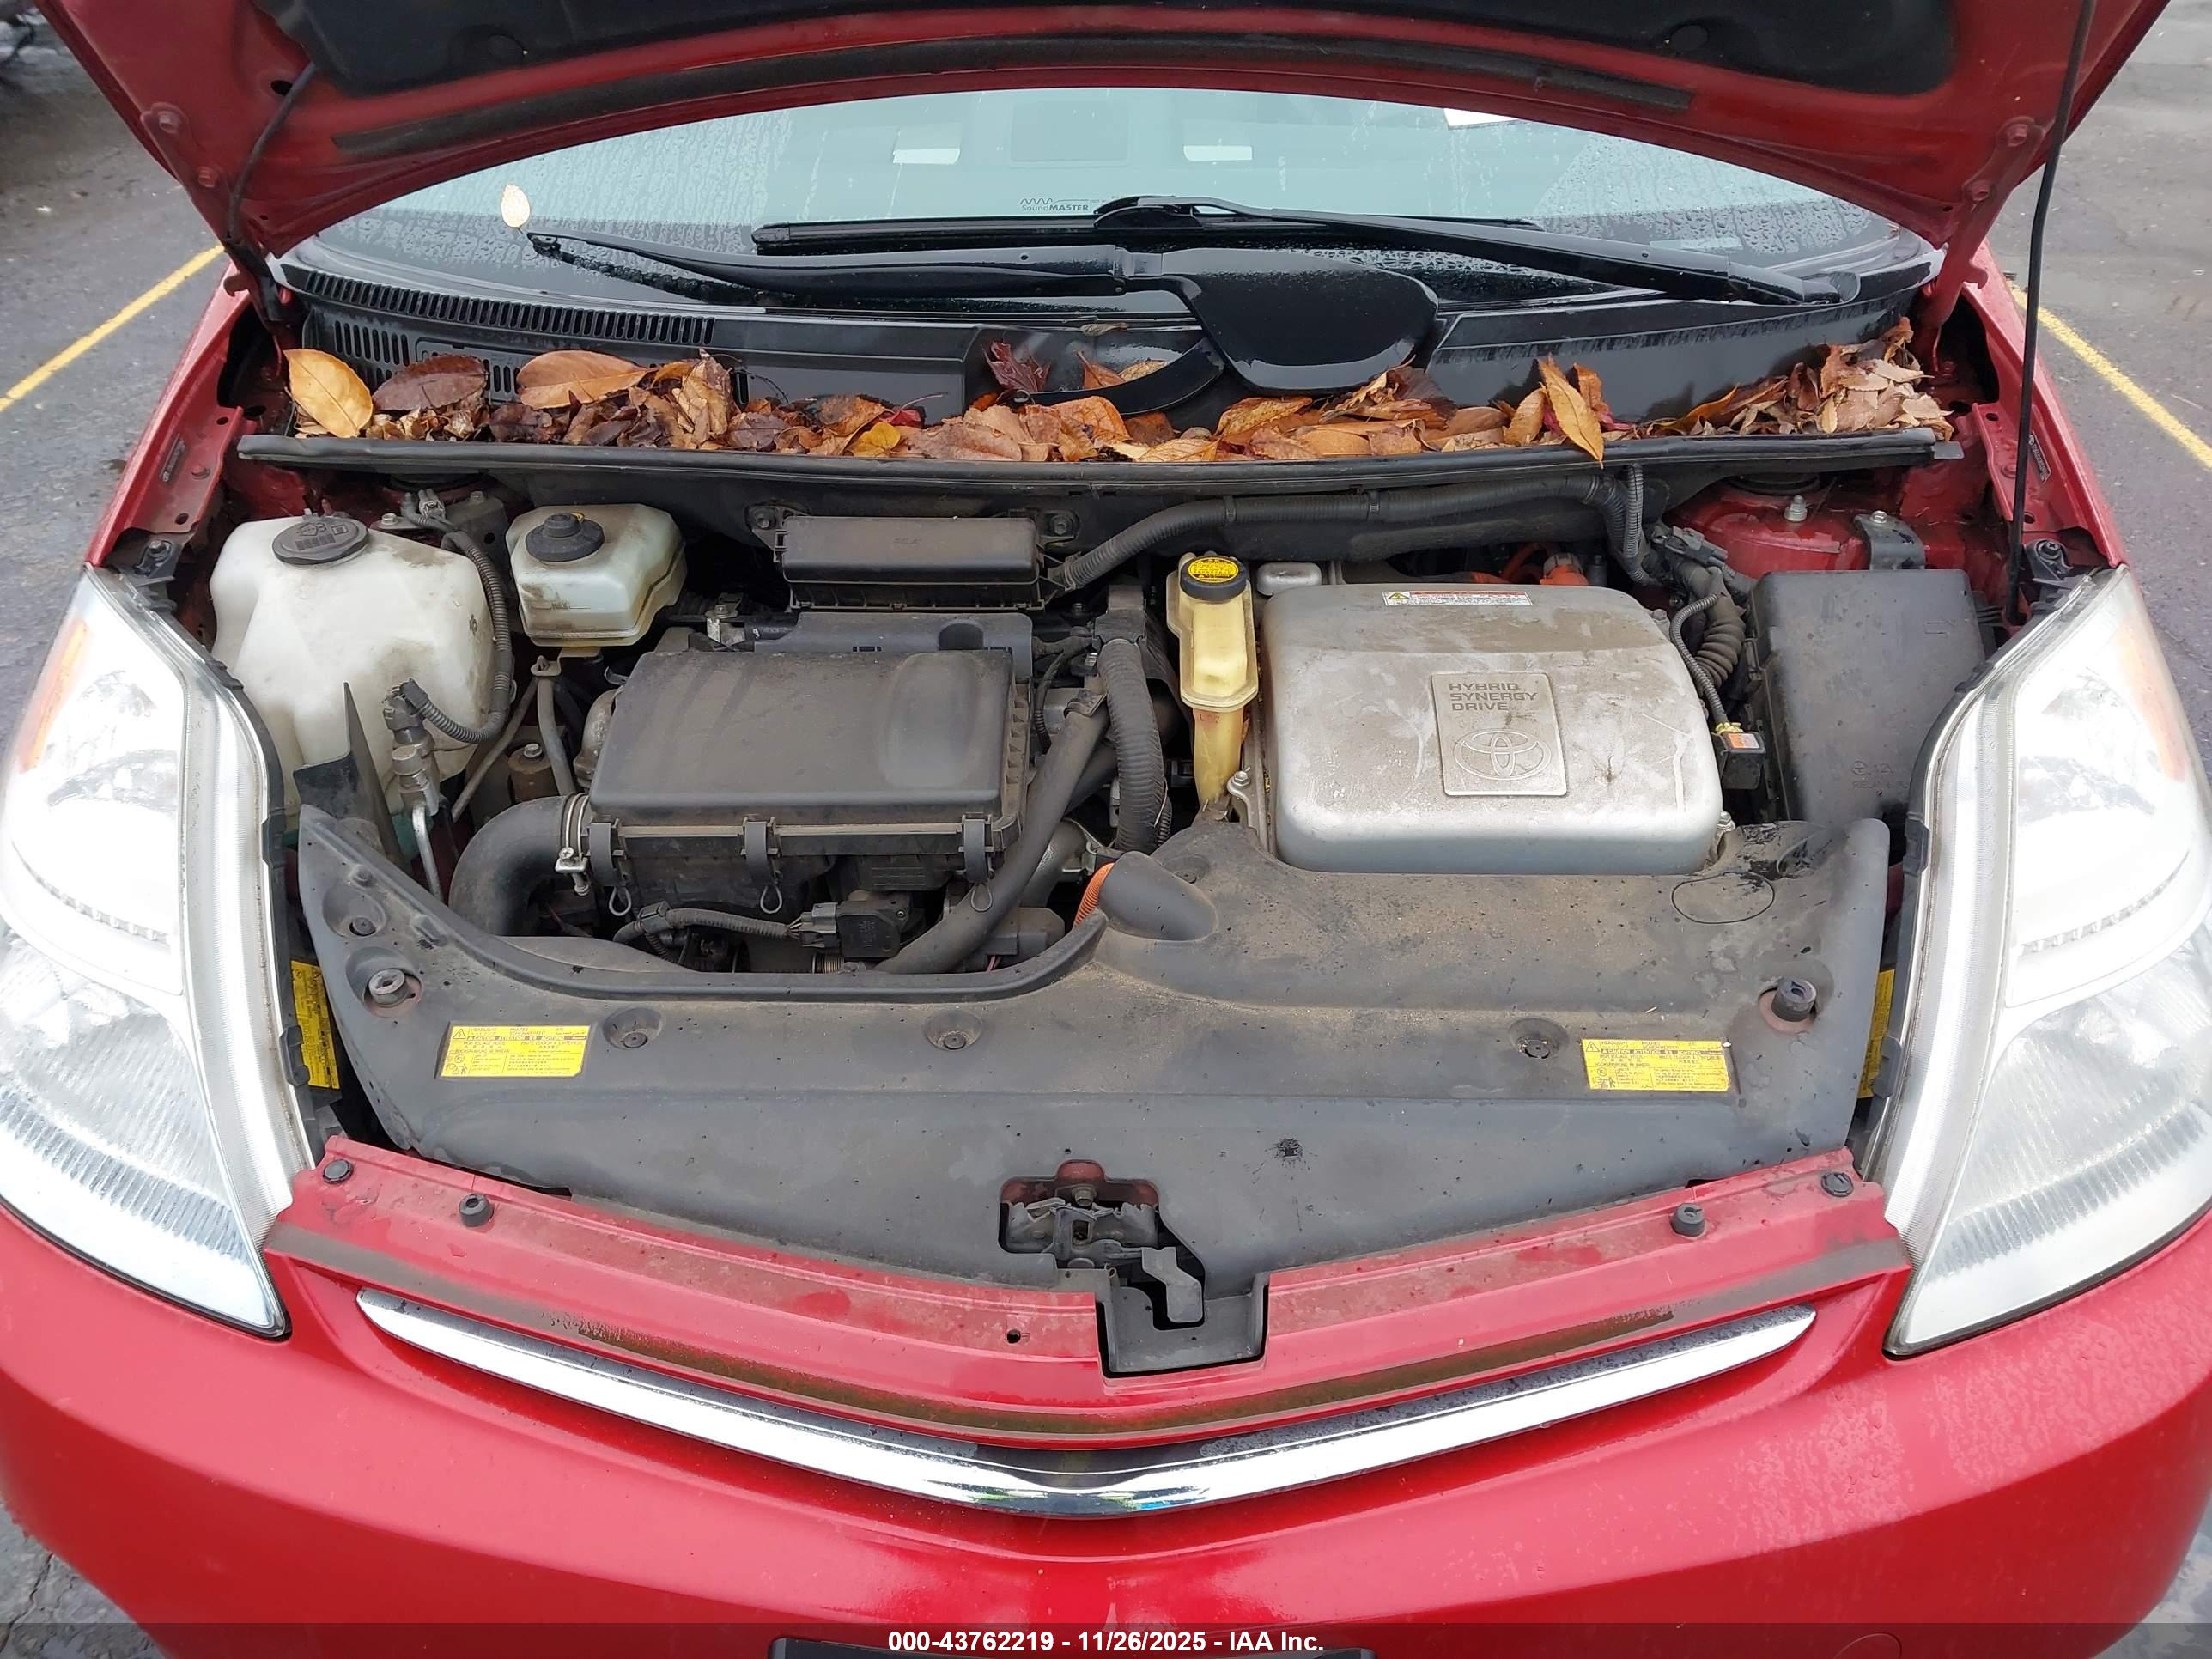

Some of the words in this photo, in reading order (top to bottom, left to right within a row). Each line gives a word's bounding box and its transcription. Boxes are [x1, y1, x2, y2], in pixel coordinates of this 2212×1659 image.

[1449, 683, 1519, 691] HYBRID
[1449, 692, 1538, 702] SYNERGY
[1452, 702, 1509, 711] DRIVE
